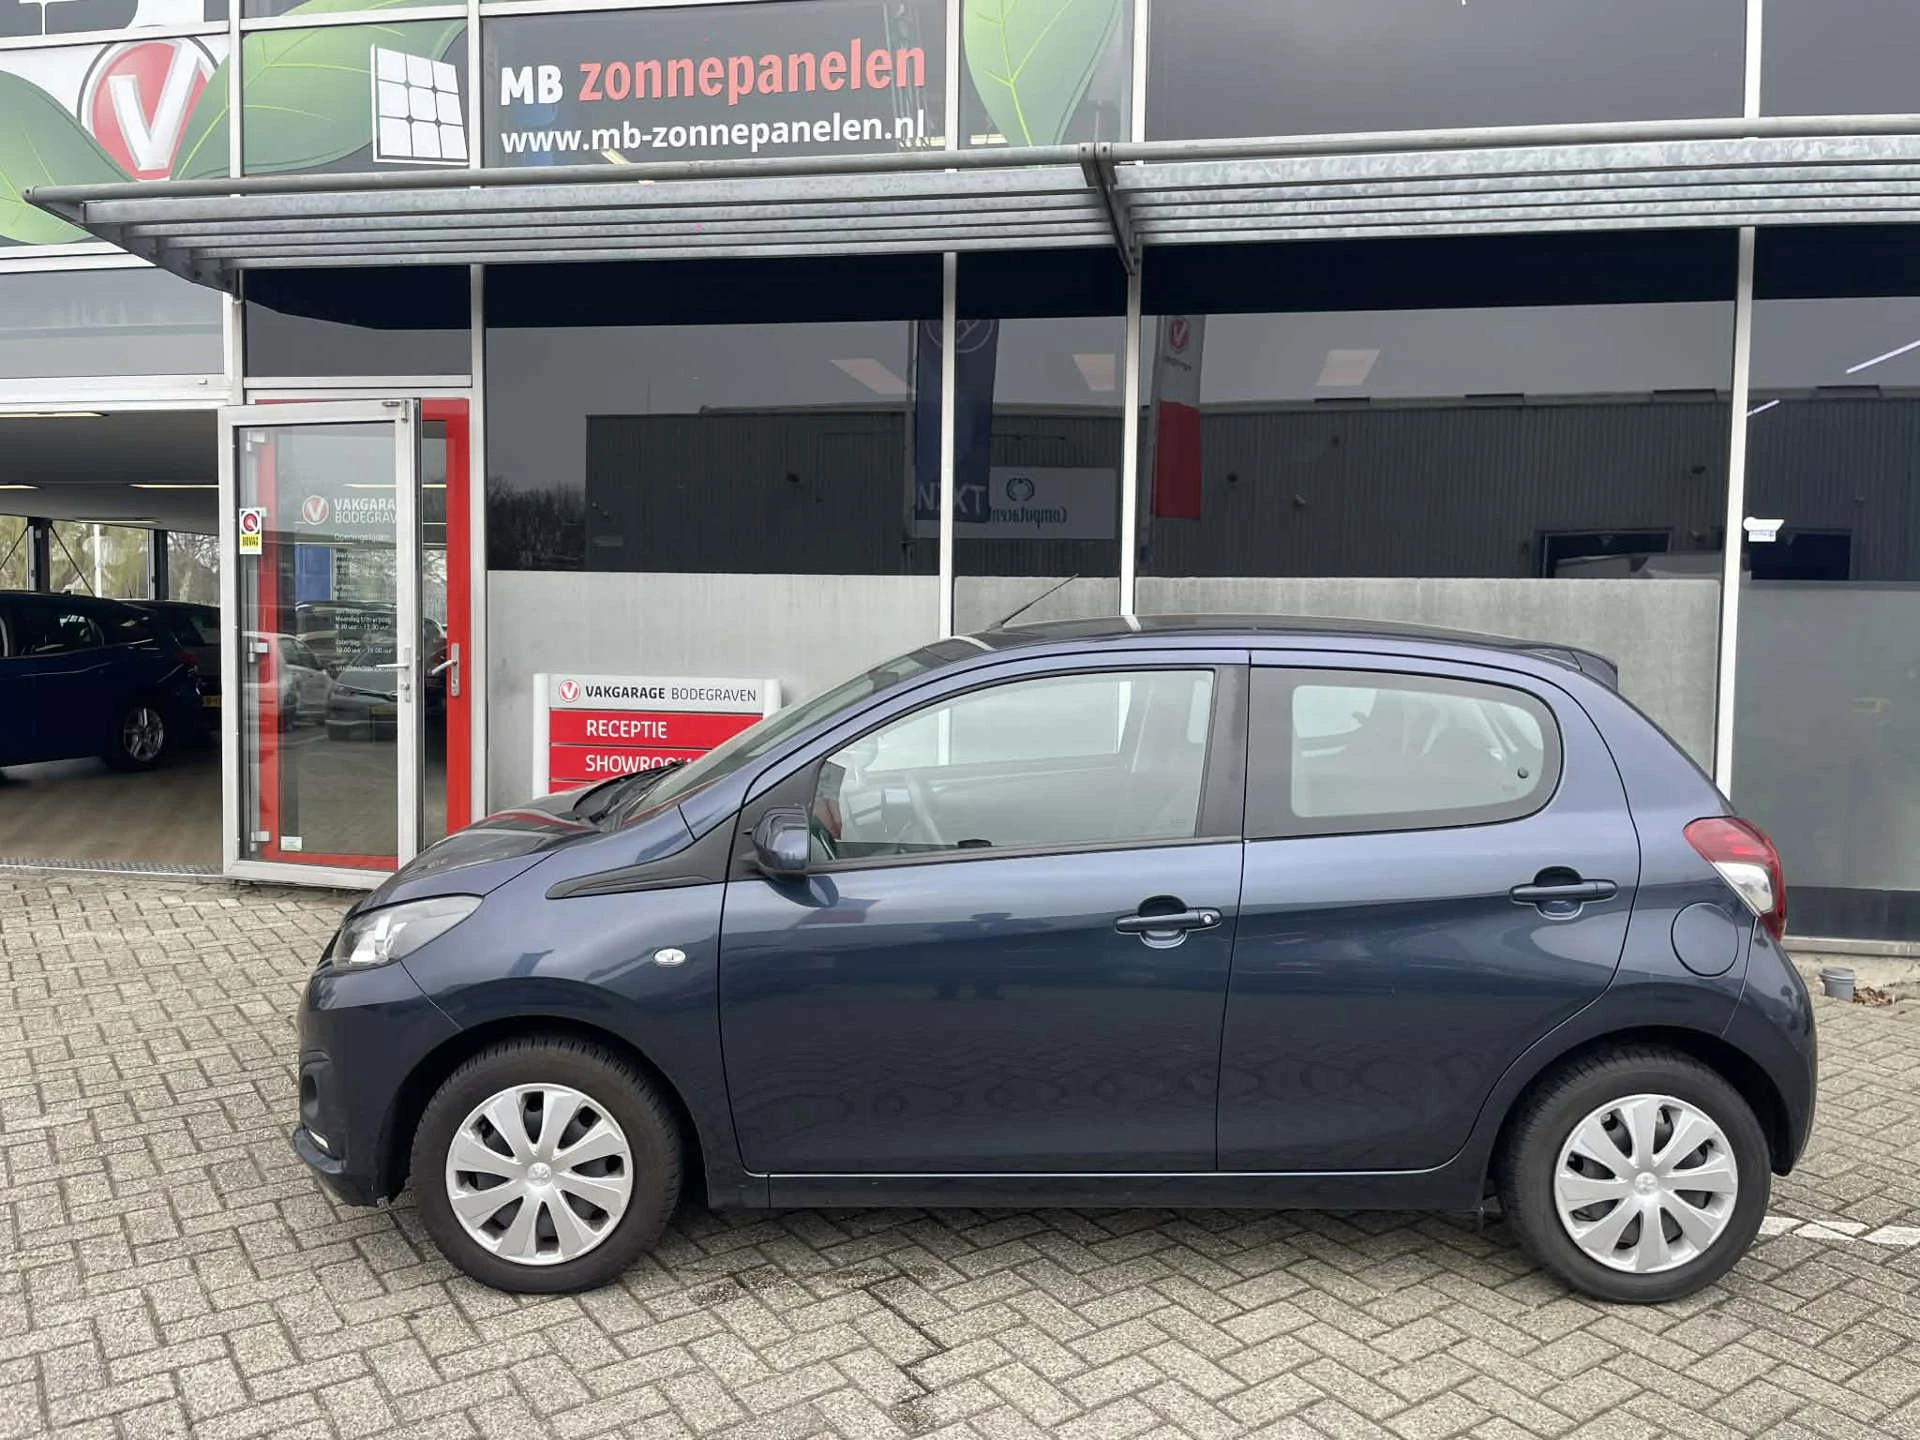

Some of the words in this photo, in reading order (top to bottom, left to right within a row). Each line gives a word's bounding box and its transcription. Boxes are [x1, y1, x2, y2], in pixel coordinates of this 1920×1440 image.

[500, 65, 564, 106] MB
[579, 38, 925, 106] zonnepanelen
[501, 109, 925, 153] www.mb-zonnepanelen.nl
[334, 497, 396, 511] VAKGARA
[335, 511, 397, 524] BODEGRAV
[586, 685, 665, 700] VAKGARAGE
[671, 687, 756, 702] BODEGRAVEN
[586, 719, 668, 739] RECEPTIE
[585, 754, 692, 773] SHOWRO
